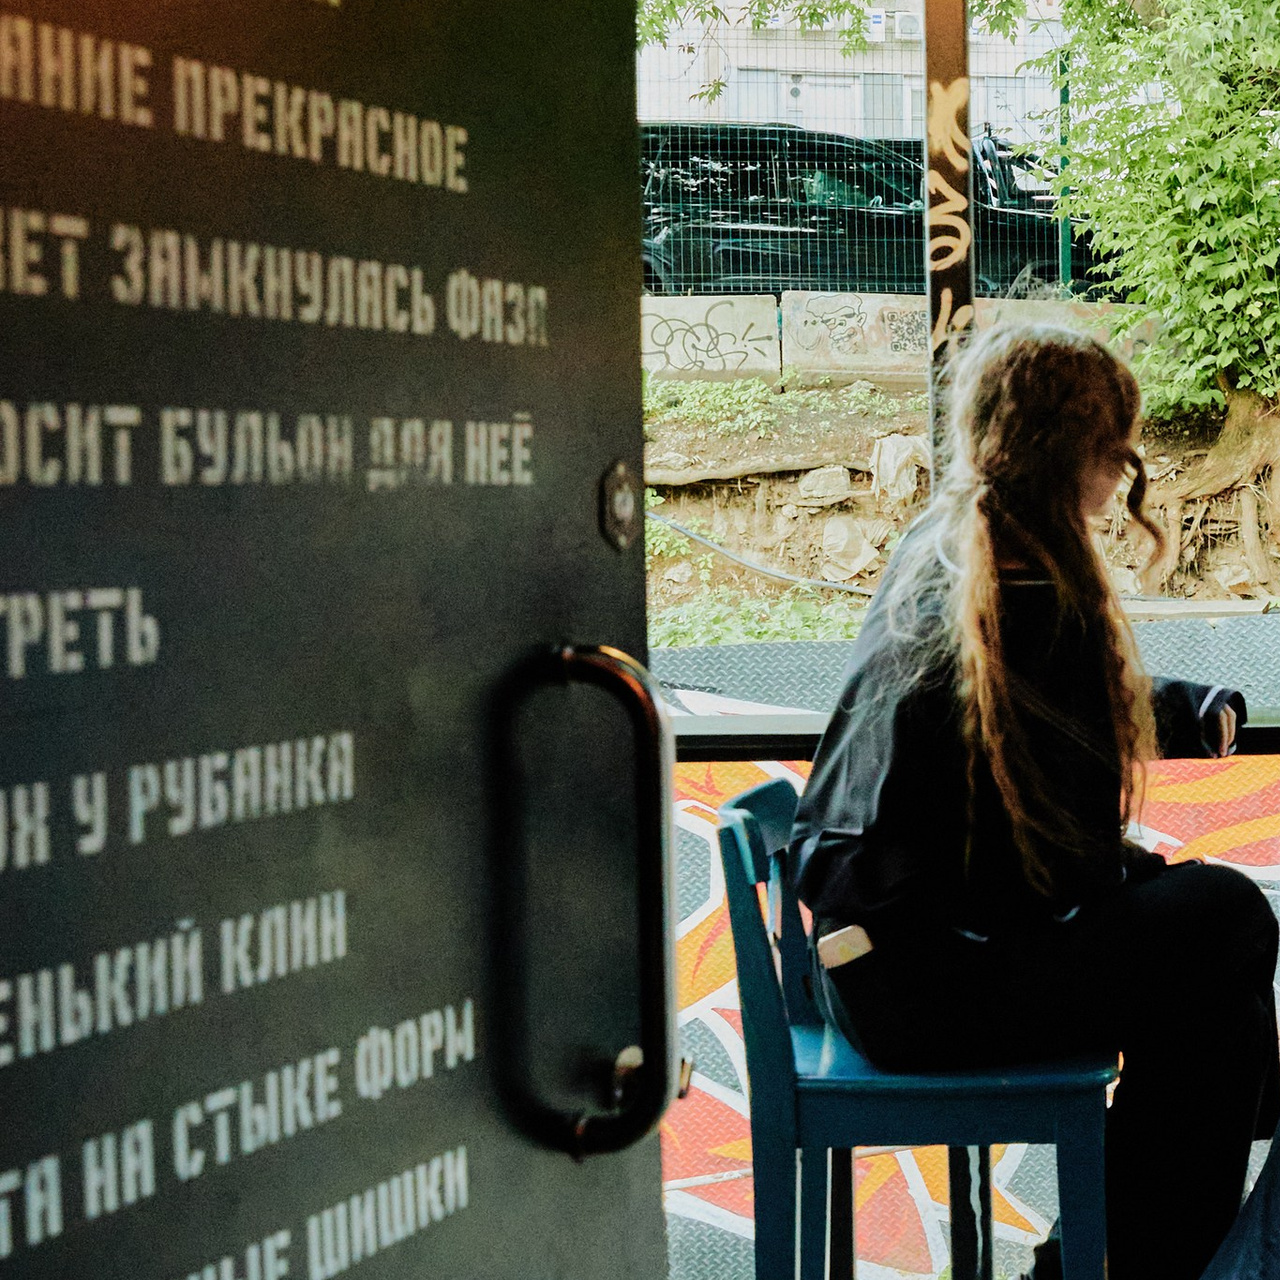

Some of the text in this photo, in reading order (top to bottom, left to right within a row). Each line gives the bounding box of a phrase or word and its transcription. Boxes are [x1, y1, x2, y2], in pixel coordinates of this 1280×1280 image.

[173, 47, 469, 193] ПРЕКРАСНОЕ
[0, 206, 89, 300] ЕТ
[111, 223, 436, 337] ЗАМКНУЛАСЬ
[159, 407, 353, 487] БУЛЬОН
[464, 412, 534, 487] НЕЁ
[0, 586, 160, 679] РЕТЬ
[0, 730, 355, 870] Х У РУБАНКА
[220, 889, 347, 995] КЛИН
[82, 1119, 156, 1218] НА
[173, 1047, 342, 1180] СТЫКЕ
